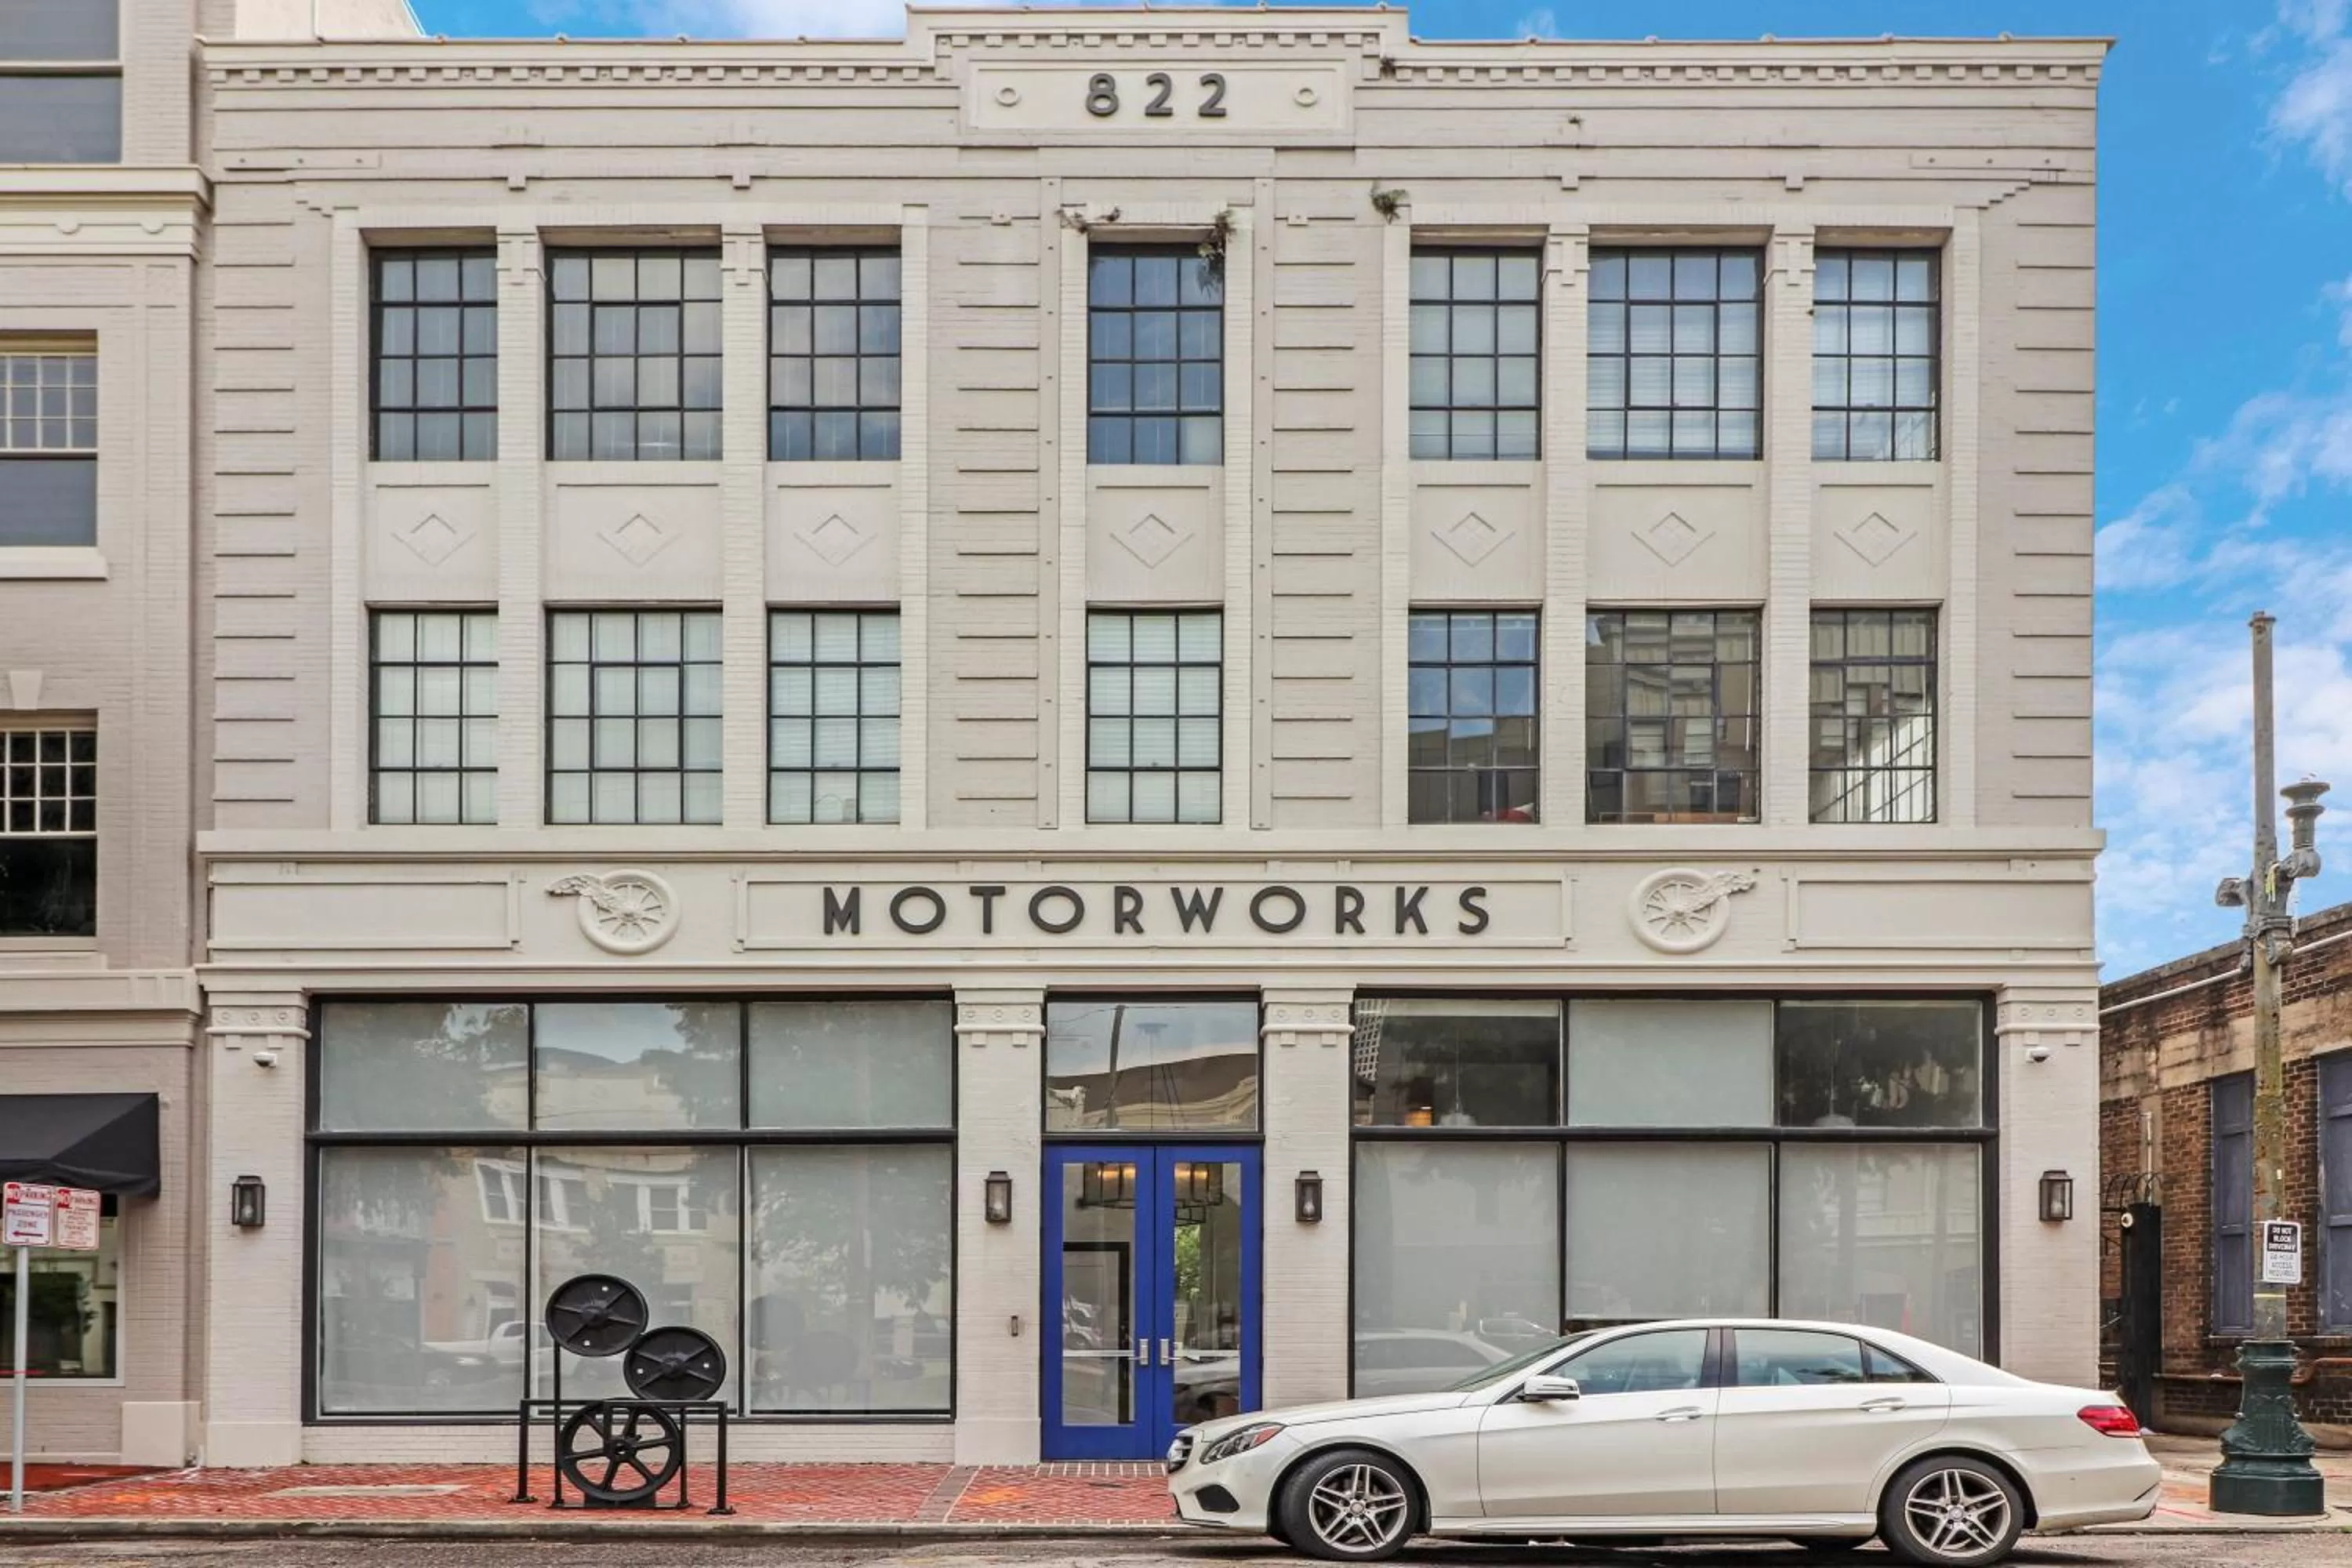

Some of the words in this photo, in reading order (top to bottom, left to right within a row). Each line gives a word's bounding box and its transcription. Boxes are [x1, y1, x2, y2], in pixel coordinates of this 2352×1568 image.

[1086, 73, 1227, 117] 822
[823, 886, 1490, 935] MOTORWORKS
[16, 1219, 38, 1228] ZONE
